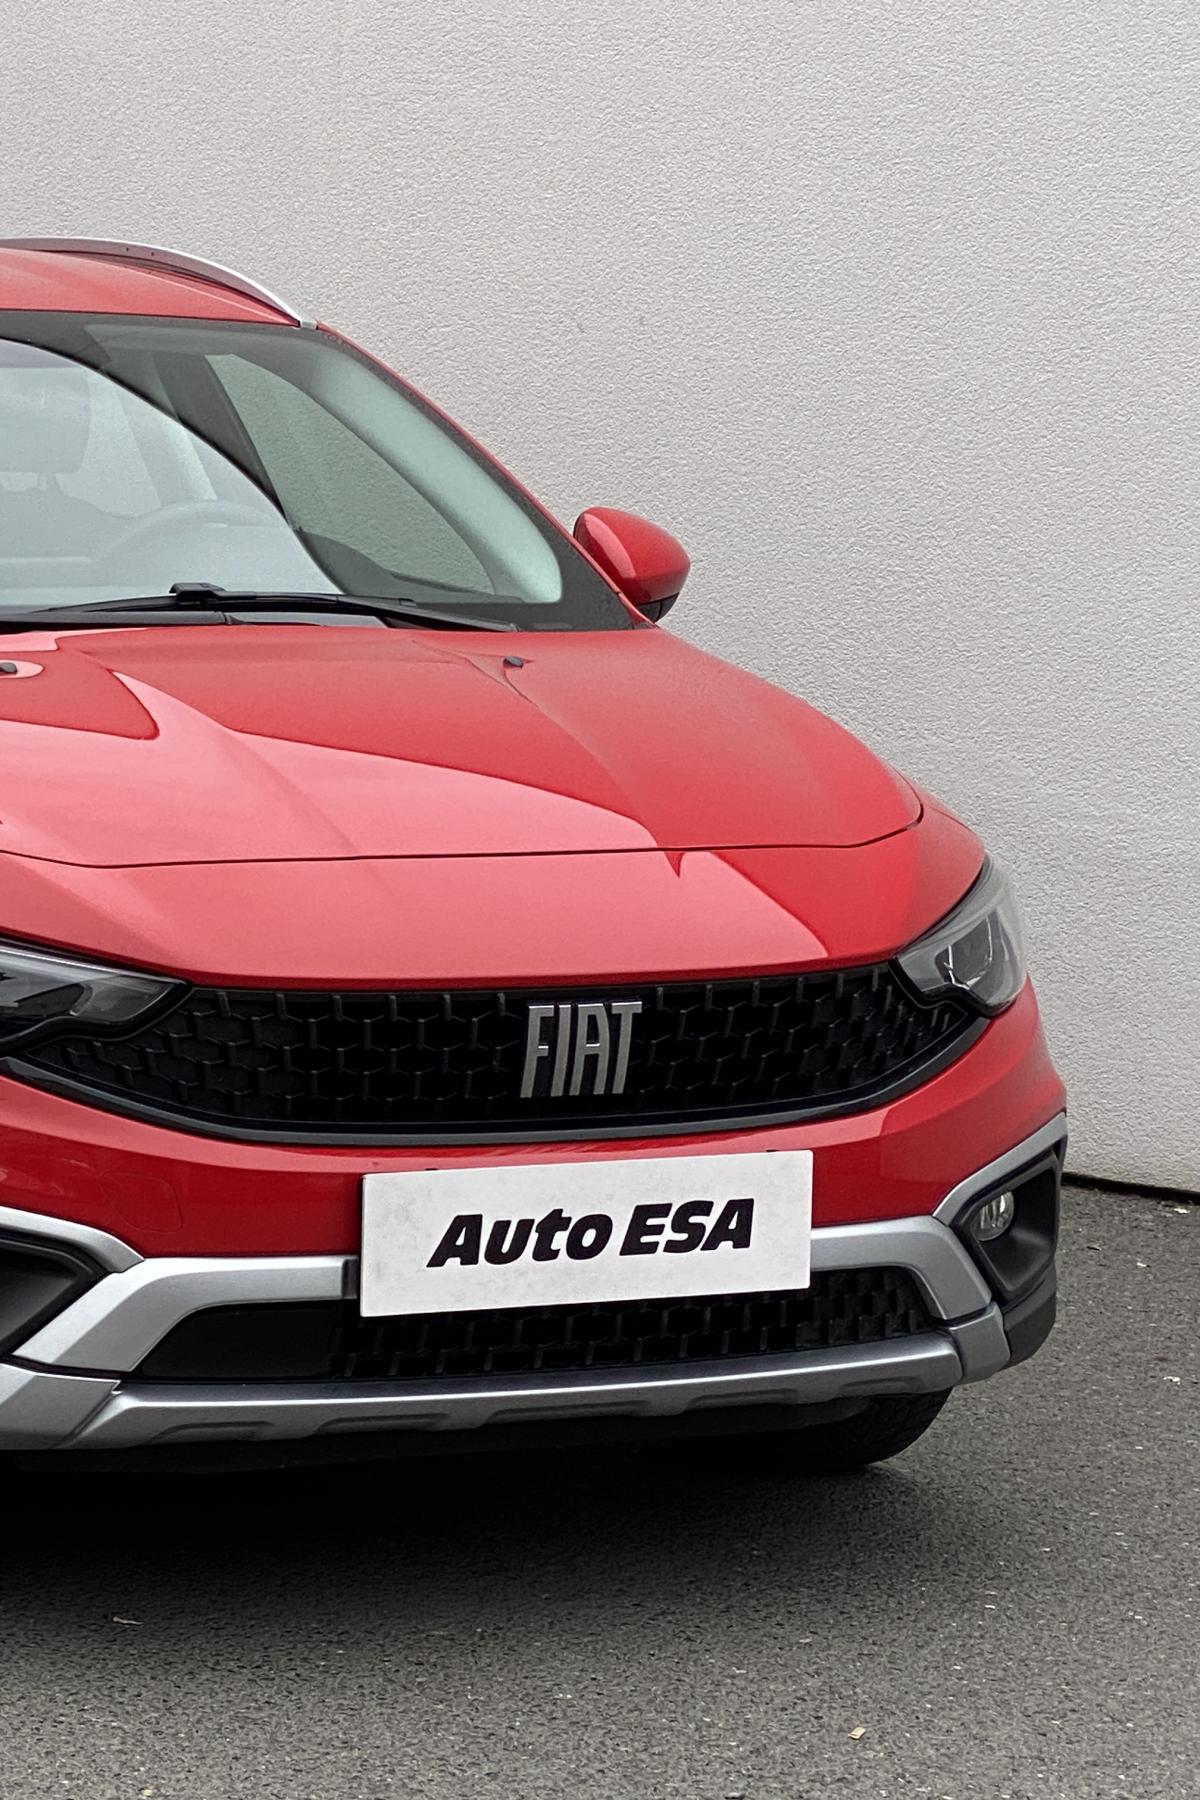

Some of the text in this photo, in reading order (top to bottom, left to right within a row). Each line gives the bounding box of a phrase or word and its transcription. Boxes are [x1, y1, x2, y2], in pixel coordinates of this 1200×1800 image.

[520, 1001, 643, 1098] FIAT
[426, 1198, 755, 1268] Auto ESA
